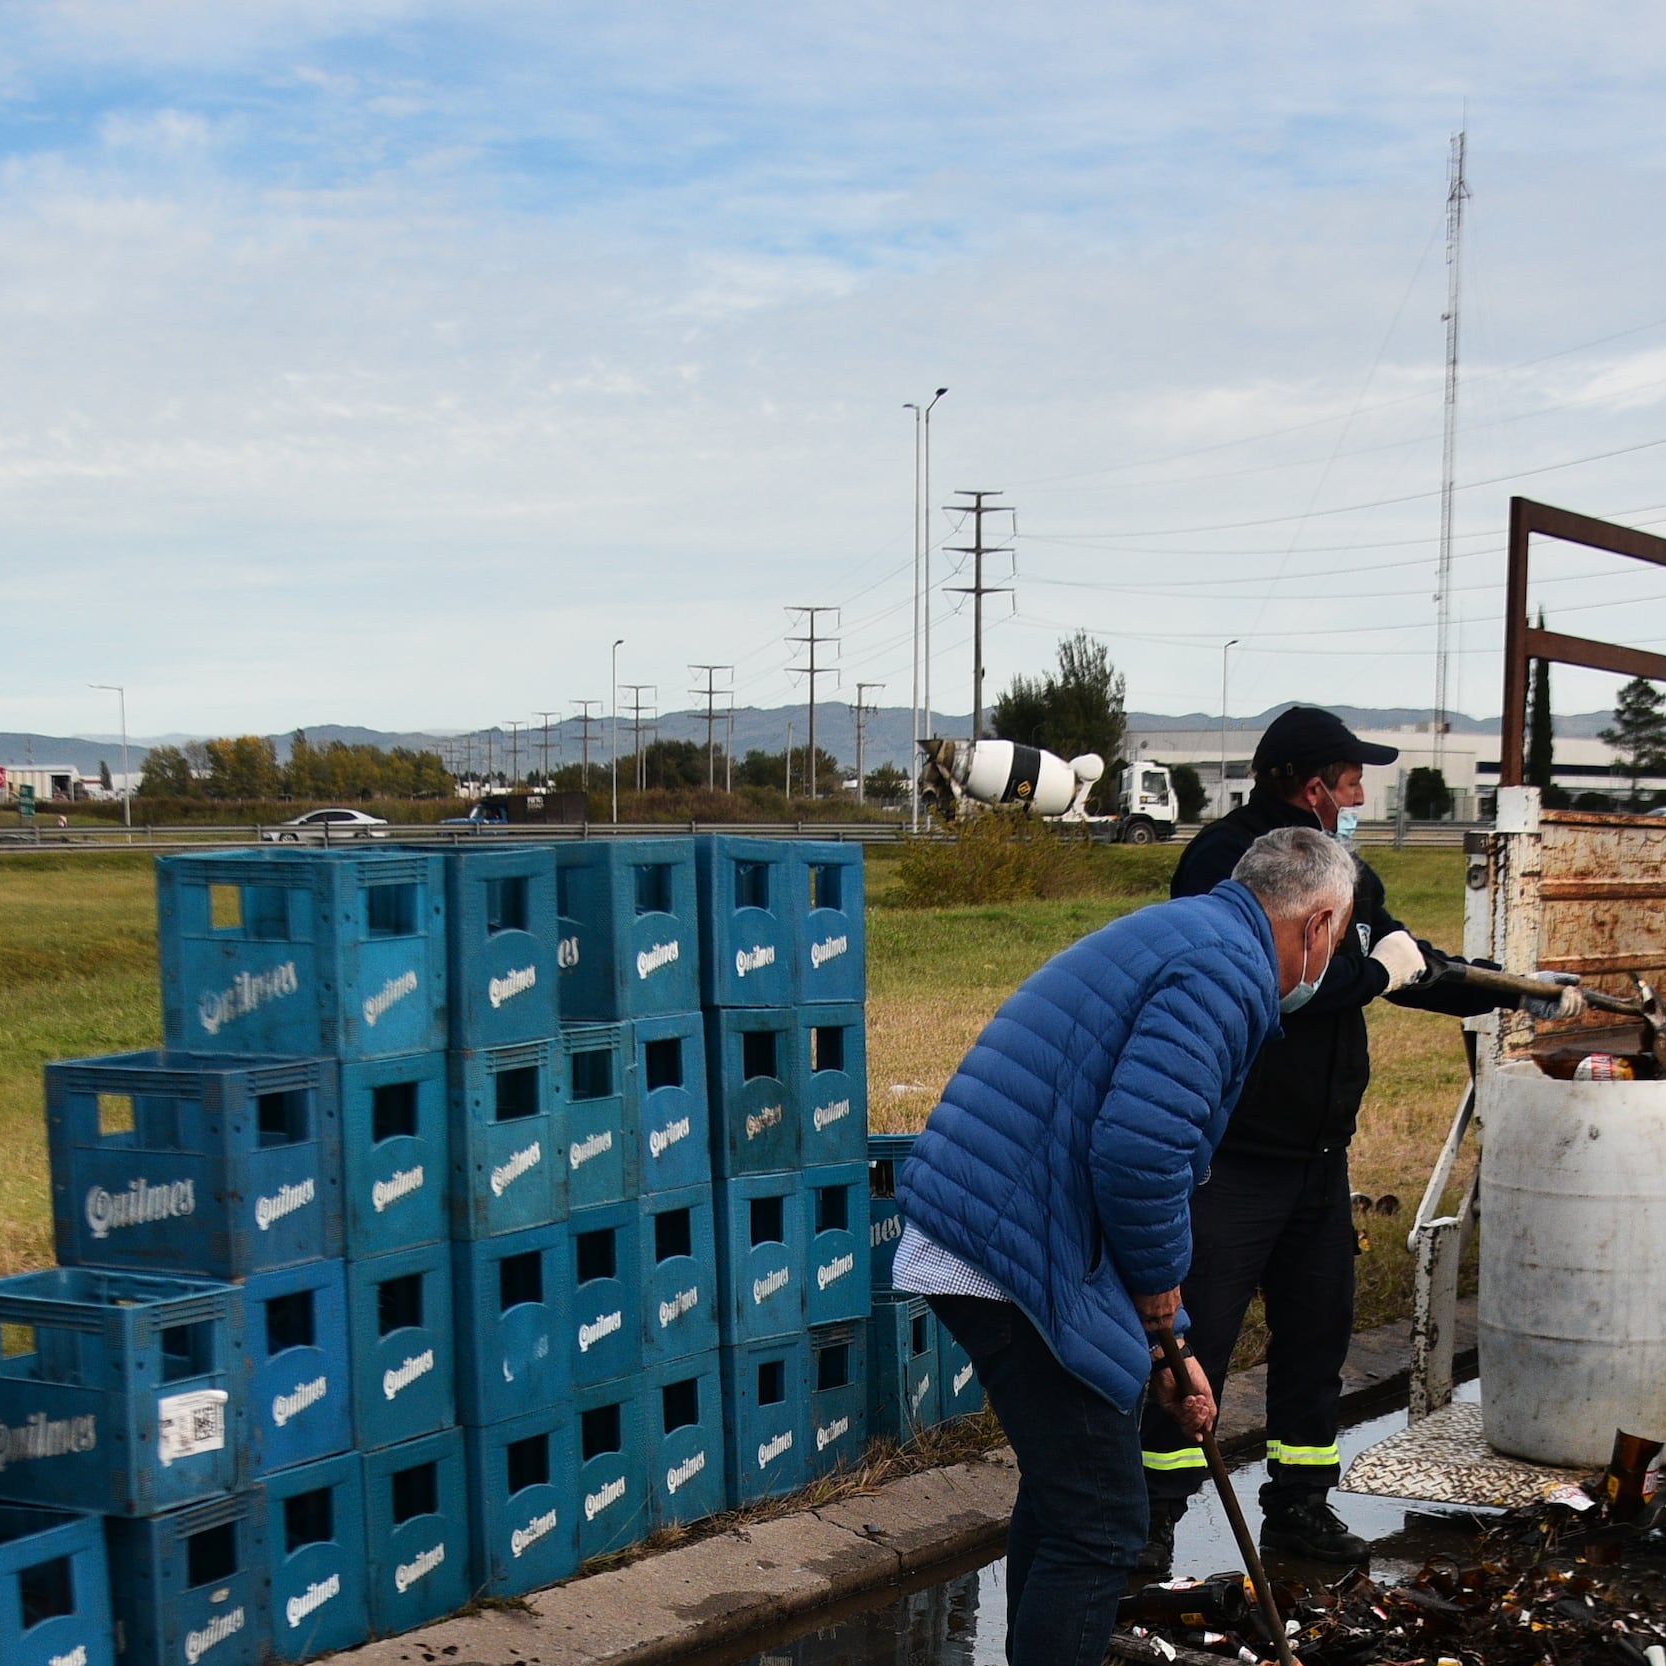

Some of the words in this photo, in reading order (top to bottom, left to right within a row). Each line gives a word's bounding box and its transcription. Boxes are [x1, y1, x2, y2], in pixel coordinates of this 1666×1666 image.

[637, 941, 679, 979] Quilmes
[736, 945, 775, 976] Quilmes
[811, 936, 847, 968] Quilmes
[363, 971, 418, 1026] Quilmes
[489, 966, 536, 1008] Quilmes
[814, 1099, 849, 1131] Quilmes
[570, 1131, 612, 1169] Quilmes
[650, 1117, 689, 1157] Quilmes
[372, 1166, 423, 1212] Quilmes
[491, 1142, 540, 1196] Quilmes
[86, 1178, 195, 1238] Quilmes
[256, 1179, 314, 1230] Quilmes
[753, 1267, 789, 1304] Quilmes
[817, 1254, 853, 1290] Quilmes
[659, 1287, 698, 1328] Quilmes
[579, 1311, 621, 1352] Quilmes
[383, 1350, 433, 1400] Quilmes
[273, 1377, 326, 1426] Quilmes
[758, 1431, 792, 1469] Quilmes
[817, 1417, 848, 1451] Quilmes
[667, 1451, 705, 1494] Quilmes
[585, 1477, 625, 1521] Quilmes
[511, 1509, 557, 1558] Quilmes
[395, 1543, 444, 1593] Quilmes
[287, 1574, 339, 1627] Quilmes
[185, 1605, 244, 1665] Quilmes
